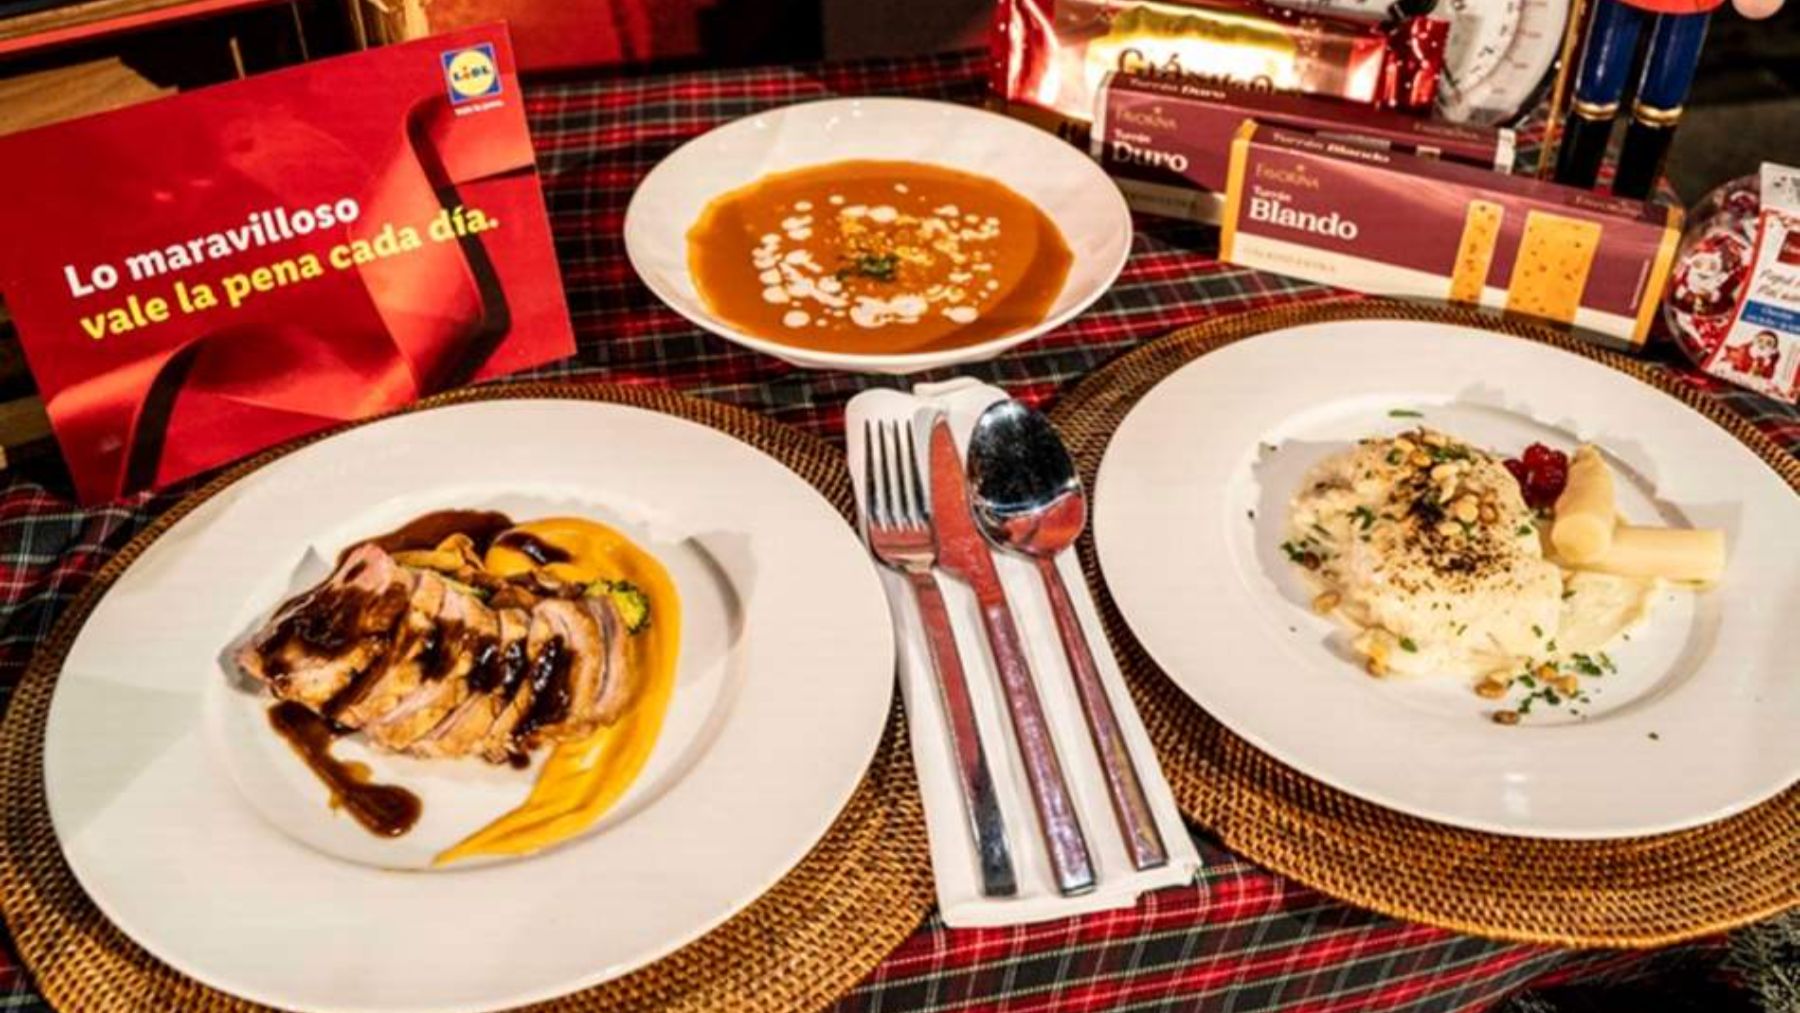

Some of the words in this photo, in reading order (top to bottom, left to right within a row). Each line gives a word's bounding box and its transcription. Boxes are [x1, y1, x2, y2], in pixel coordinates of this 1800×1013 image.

[1181, 84, 1227, 99] Duro
[1112, 141, 1189, 172] Duro
[1326, 142, 1391, 163] Blando
[1248, 198, 1359, 241] Blando
[63, 264, 119, 299] Lo
[124, 197, 361, 281] maravilloso
[79, 294, 171, 341] vale
[174, 281, 218, 314] la
[221, 253, 324, 307] pena
[329, 222, 423, 270] cada
[428, 205, 500, 242] día.
